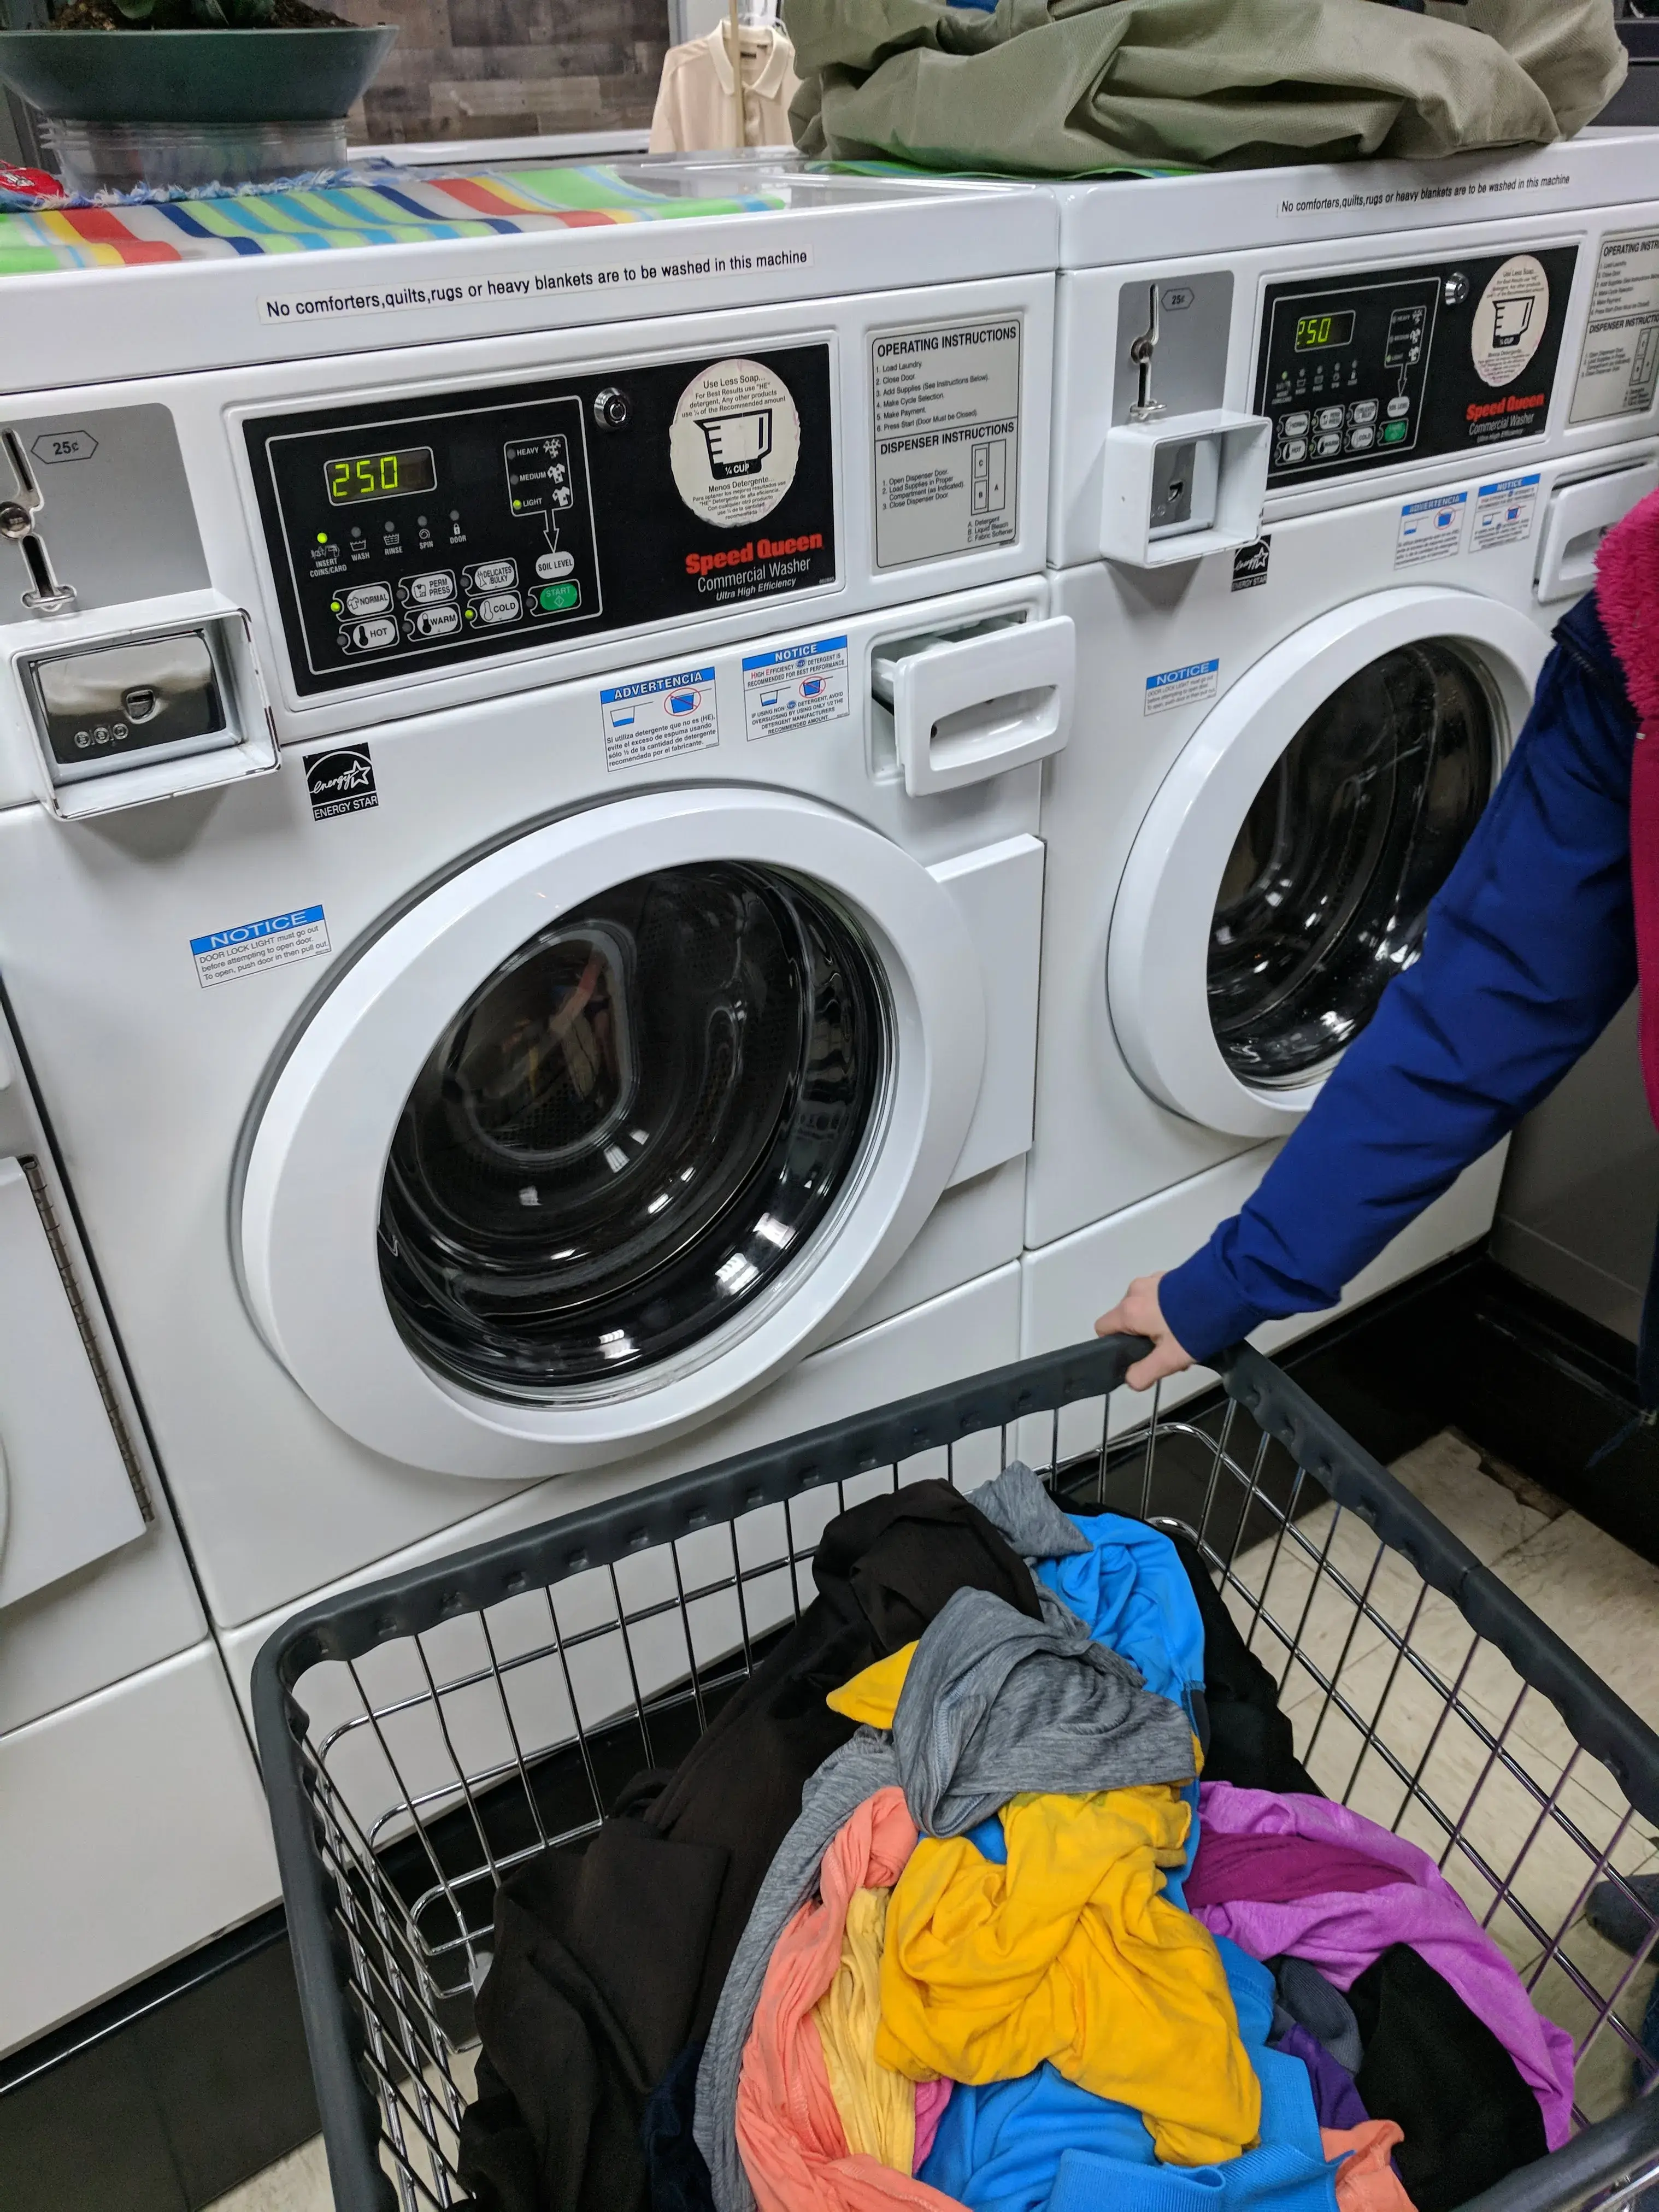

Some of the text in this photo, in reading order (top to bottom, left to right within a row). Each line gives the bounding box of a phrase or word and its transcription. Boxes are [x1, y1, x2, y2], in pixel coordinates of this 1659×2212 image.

[1282, 201, 1293, 213] No
[1296, 193, 1382, 211] comforters,quilts,rugs
[1396, 191, 1419, 202] heavy
[1421, 186, 1451, 199] blankets
[1455, 187, 1466, 196] are
[1469, 185, 1475, 193] to
[1478, 184, 1486, 193] be
[1490, 179, 1516, 192] washed
[1518, 179, 1524, 189] in
[1527, 177, 1539, 188] this
[1541, 174, 1569, 186] machine
[267, 251, 807, 317] No comforters,quilts,rugs or heavy blankets are to be washed in this machine
[878, 327, 1016, 357] OPERATING INSTRUCTIONS
[883, 363, 897, 372] Load
[703, 380, 718, 389] Use
[720, 378, 738, 386] Less
[897, 385, 921, 395] Supplies
[937, 378, 968, 388] Instructions
[722, 387, 743, 395] Results
[1466, 393, 1545, 422] Speed Queen
[1469, 412, 1534, 436] Commercial Washer
[880, 422, 1014, 454] DISPENSER INSTRUCTIONS
[54, 441, 79, 456] 25¢
[517, 447, 539, 456] HEAVY
[733, 463, 749, 473] CUP
[333, 456, 398, 497] 250
[520, 472, 546, 481] MEDIUM
[709, 483, 730, 492] Menos
[1497, 479, 1522, 491] NOTICE
[523, 498, 542, 507] LIGHT
[420, 541, 433, 550] SPIN
[450, 535, 466, 544] DOOR
[351, 552, 370, 561] WASH
[385, 546, 403, 555] RINSE
[686, 533, 823, 575] Speed Queen
[316, 558, 337, 568] INSERT
[538, 560, 573, 572] SOIL LEVEL
[310, 564, 346, 577] COINS/CARD
[484, 567, 511, 578] DELICATES
[698, 557, 810, 592] Commercial Washer
[430, 579, 447, 588] PERM
[716, 578, 796, 601] Ultra High Efficiency
[430, 586, 450, 596] PRESS
[546, 586, 570, 597] START
[359, 594, 388, 604] NORMAL
[494, 603, 515, 613] COLD
[431, 615, 456, 625] WARM
[370, 628, 387, 638] HOT
[775, 644, 817, 662] NOTICE
[808, 655, 833, 666] DETERGENT
[748, 674, 784, 687] RECOMMENDED
[810, 660, 844, 673] PERFORMANCE
[1157, 662, 1209, 685] NOTICE
[614, 672, 702, 699] ADVERTENCIA
[752, 713, 787, 725] OVERSUDSING
[762, 719, 791, 730] DETERGENT
[792, 707, 835, 721] MANUFACTURERS
[615, 734, 633, 742] utiliza
[635, 725, 668, 738] detergente
[670, 722, 681, 731] que
[768, 721, 807, 734] RECOMMENDED
[608, 743, 622, 751] evite
[632, 737, 653, 745] exceso
[664, 729, 688, 740] espuma
[690, 722, 712, 732] usando
[609, 751, 622, 759] sólo
[648, 739, 673, 749] cantidad
[684, 730, 716, 743] detergente
[609, 752, 651, 767] recomendada
[653, 749, 663, 757] por
[672, 740, 703, 751] fabricante.
[314, 796, 378, 819] ENERGY STAR
[211, 911, 307, 948] NOTICE
[200, 951, 225, 963] DOOR
[227, 944, 249, 955] LOCK
[251, 937, 275, 949] LIGHT
[277, 932, 295, 942] must
[297, 929, 305, 938] go
[202, 961, 225, 972] before
[228, 950, 265, 966] attempting
[276, 942, 294, 952] open
[296, 937, 314, 945] door.
[215, 968, 236, 978] open,
[238, 961, 255, 972] push
[258, 956, 273, 966] door
[284, 950, 299, 958] then
[302, 944, 314, 954] pull
